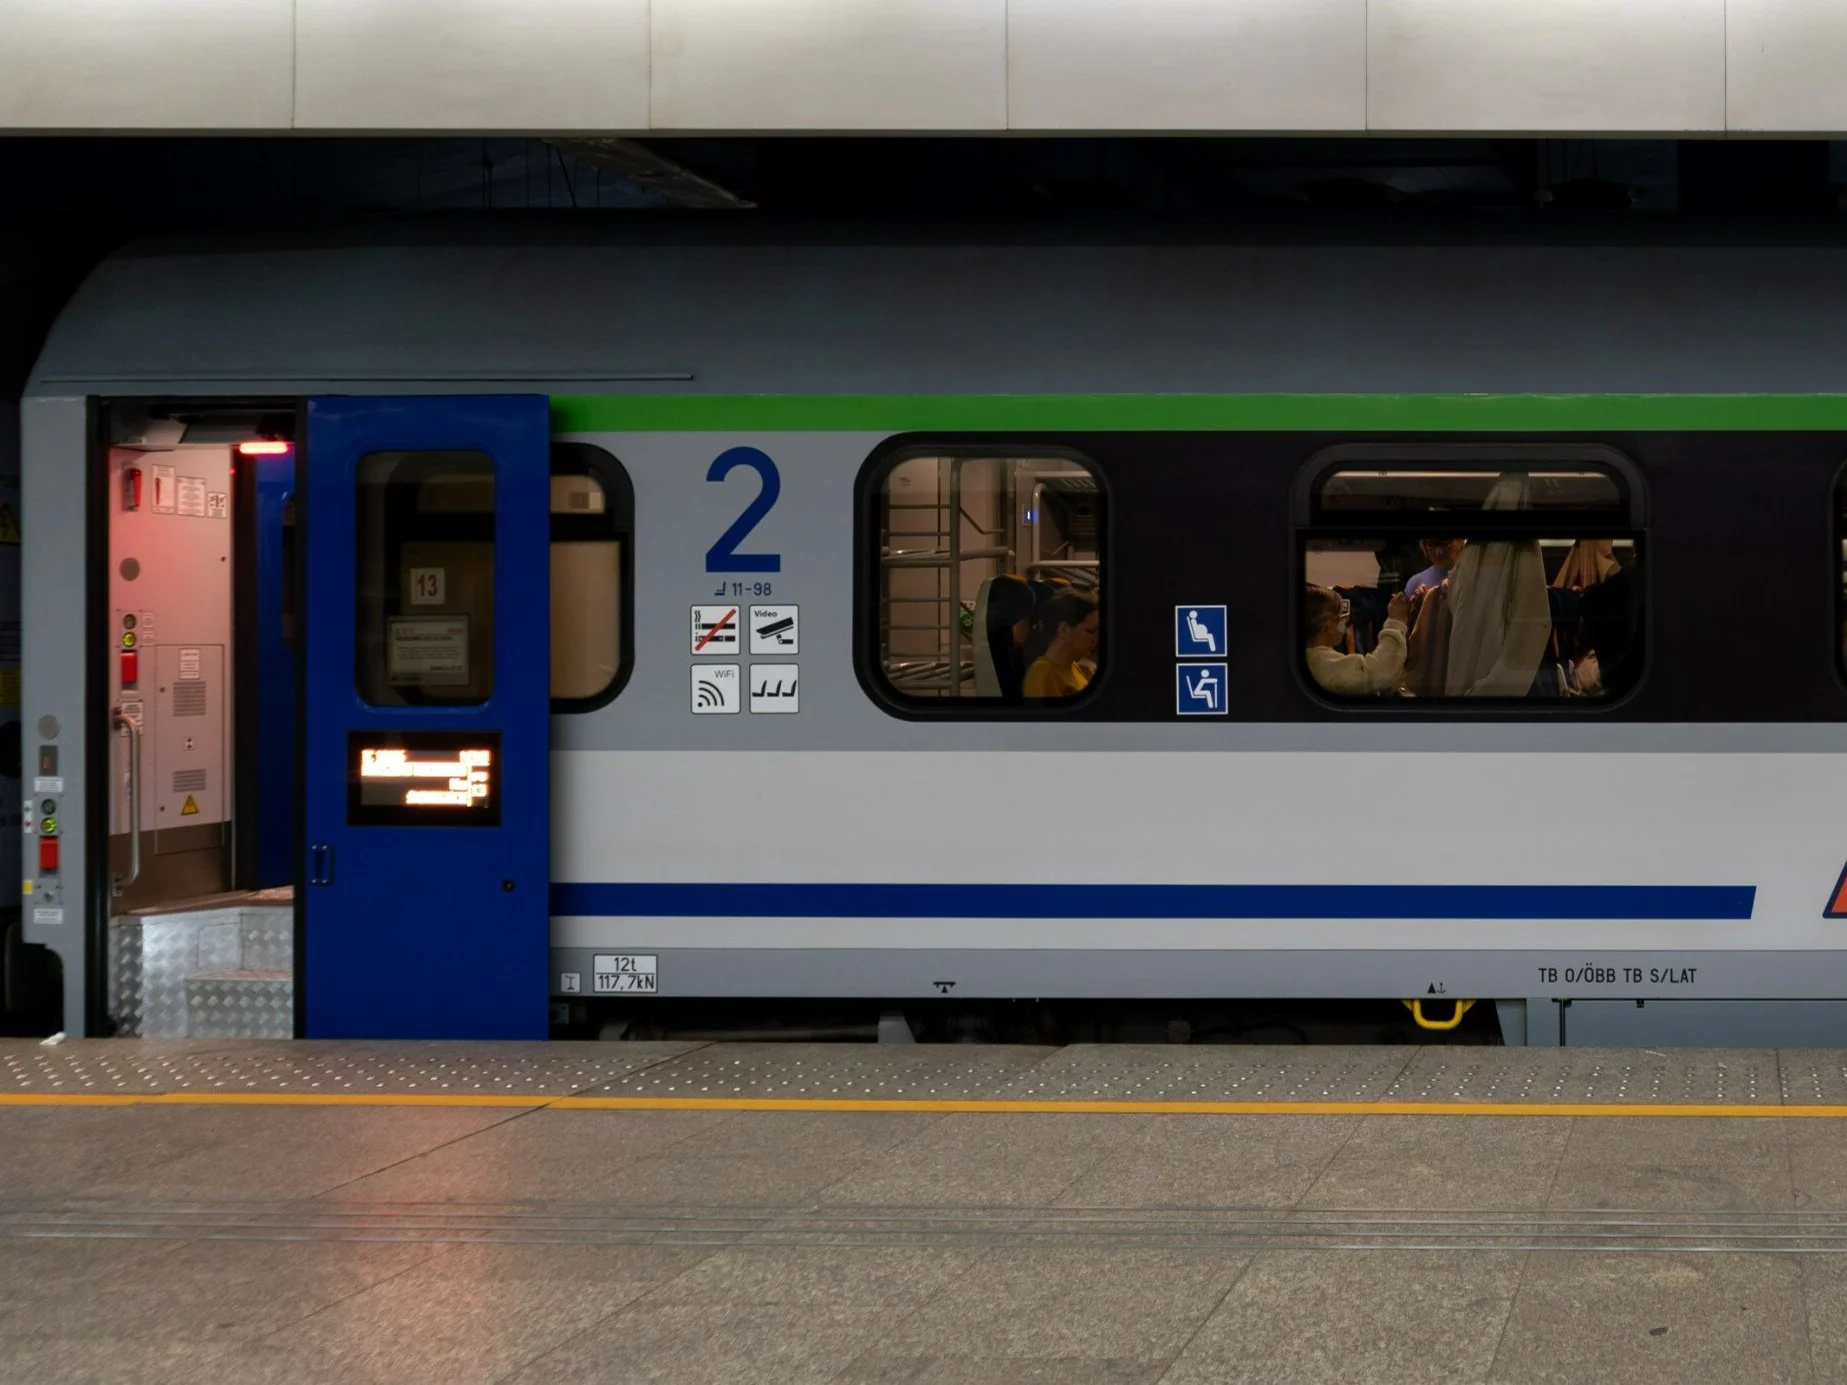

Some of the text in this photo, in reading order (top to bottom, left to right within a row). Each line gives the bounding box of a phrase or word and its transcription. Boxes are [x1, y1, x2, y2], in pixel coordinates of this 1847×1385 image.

[706, 446, 781, 573] 2
[417, 574, 438, 597] 13
[731, 582, 772, 596] 11-98
[754, 609, 778, 618] Video
[714, 670, 735, 678] WiFi
[614, 957, 637, 972] 12t
[598, 975, 655, 990] 117,7kN
[1538, 968, 1558, 983] TB
[1623, 968, 1643, 983] TB
[1650, 968, 1697, 983] S/LAT
